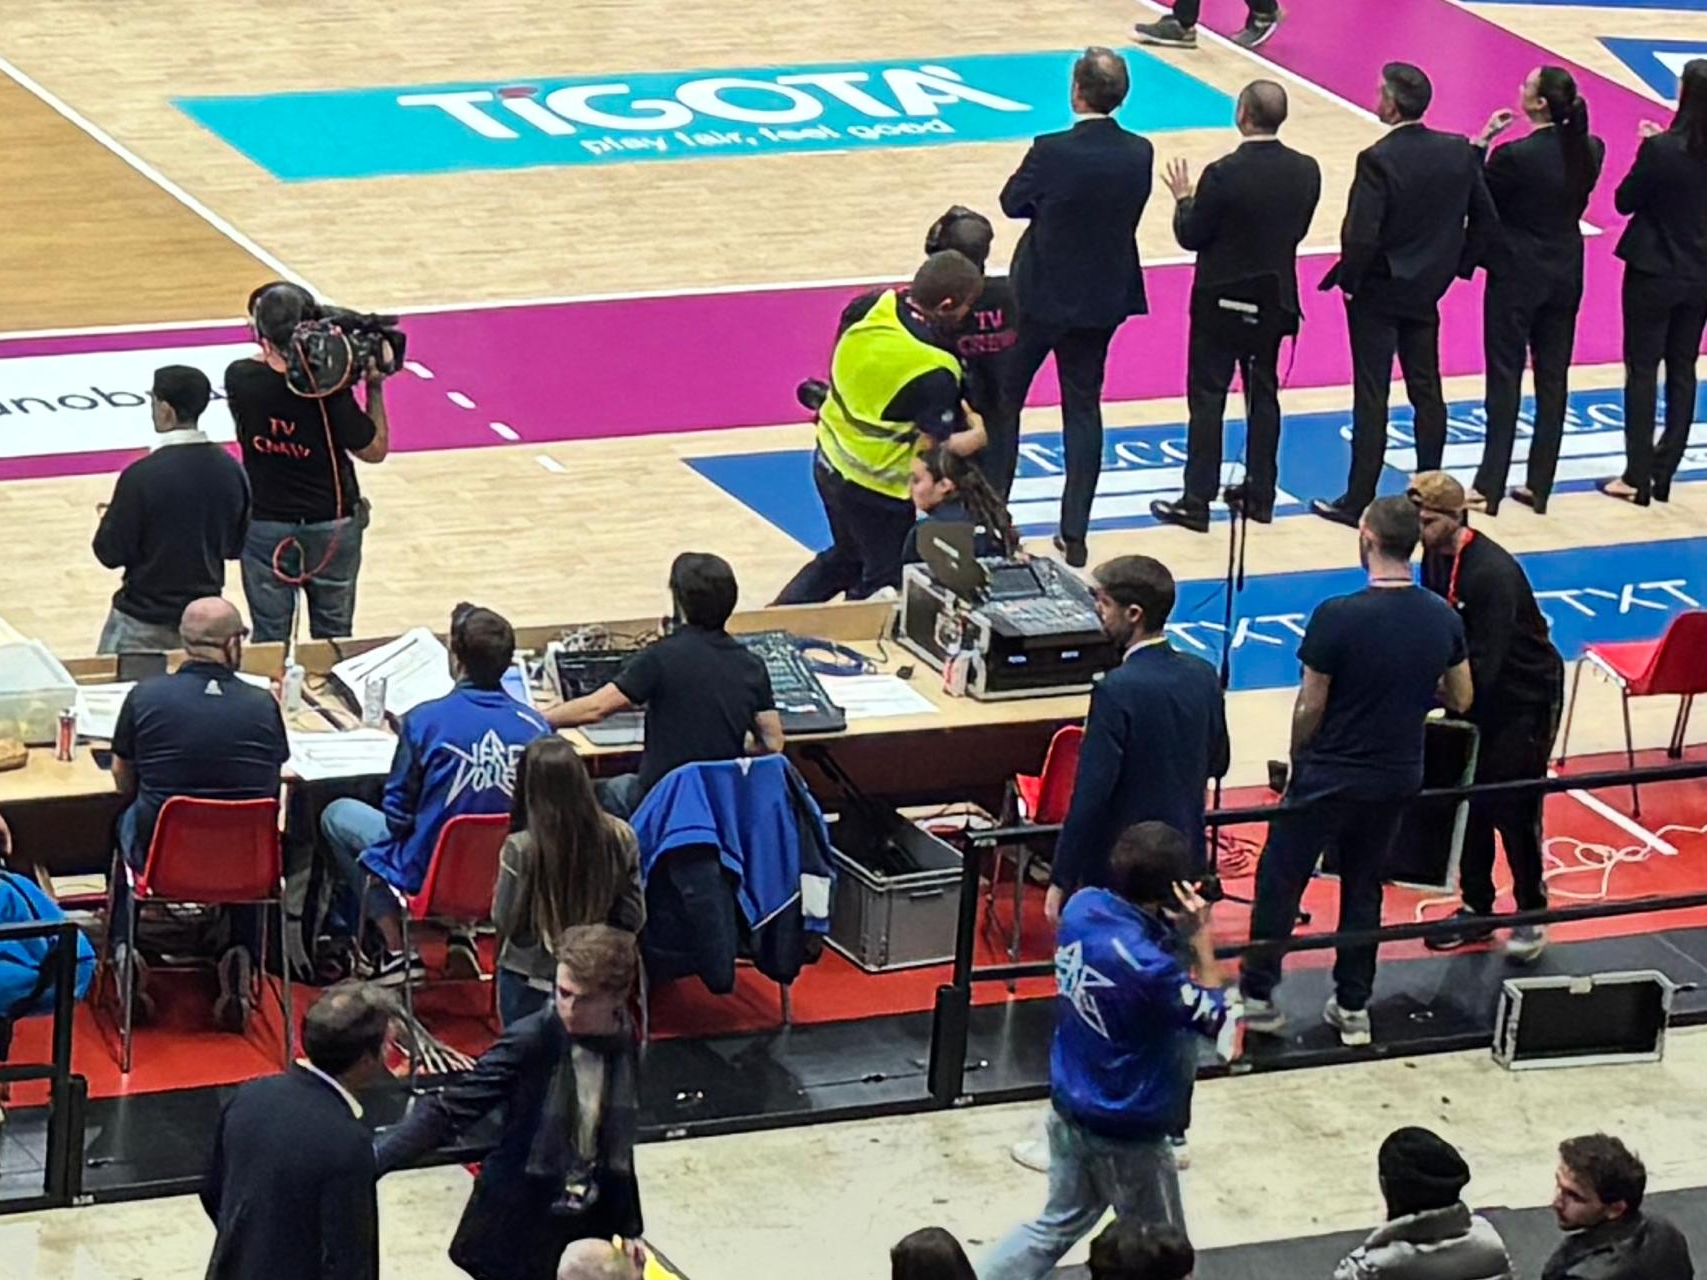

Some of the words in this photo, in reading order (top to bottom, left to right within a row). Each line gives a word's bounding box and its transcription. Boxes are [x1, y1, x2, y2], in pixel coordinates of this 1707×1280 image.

[579, 134, 669, 155] play
[846, 118, 956, 139] good
[974, 308, 1003, 329] TV
[267, 416, 296, 438] TV
